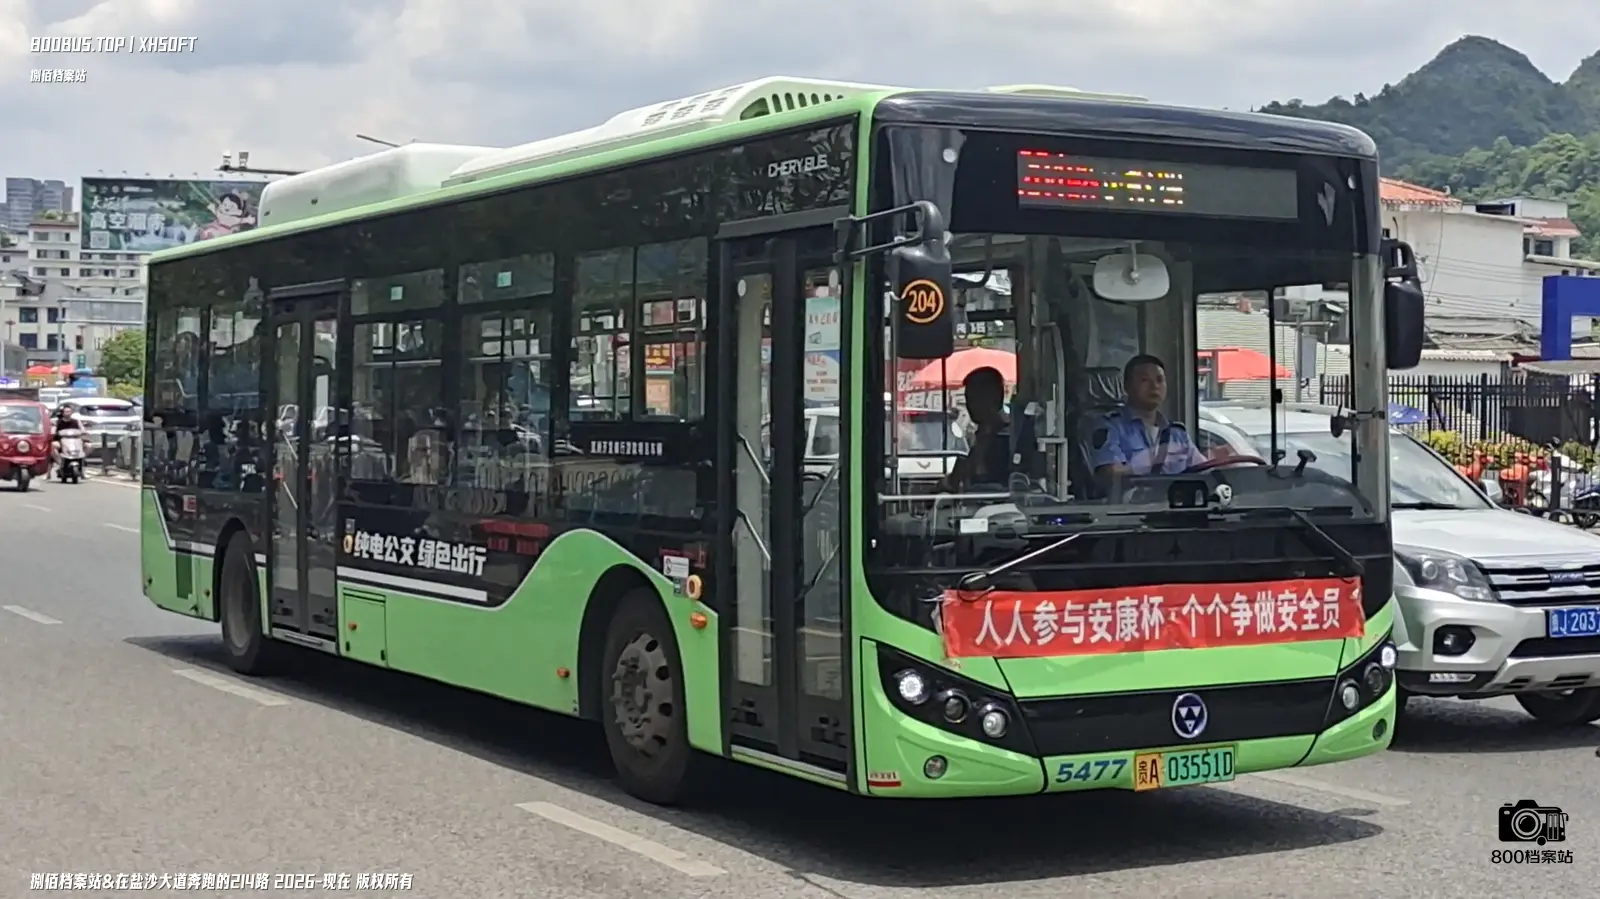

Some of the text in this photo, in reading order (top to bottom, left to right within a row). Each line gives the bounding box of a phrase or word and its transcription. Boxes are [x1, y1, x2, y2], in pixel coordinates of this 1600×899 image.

[768, 154, 829, 178] CHERY BUS
[908, 290, 937, 312] 204
[354, 530, 488, 577] 纯电公交 绿色出行
[974, 587, 1341, 646] 人人参与安康杯 个个争做安全员
[1055, 758, 1128, 784] 5477
[1138, 751, 1233, 785] 贵A 03551D
